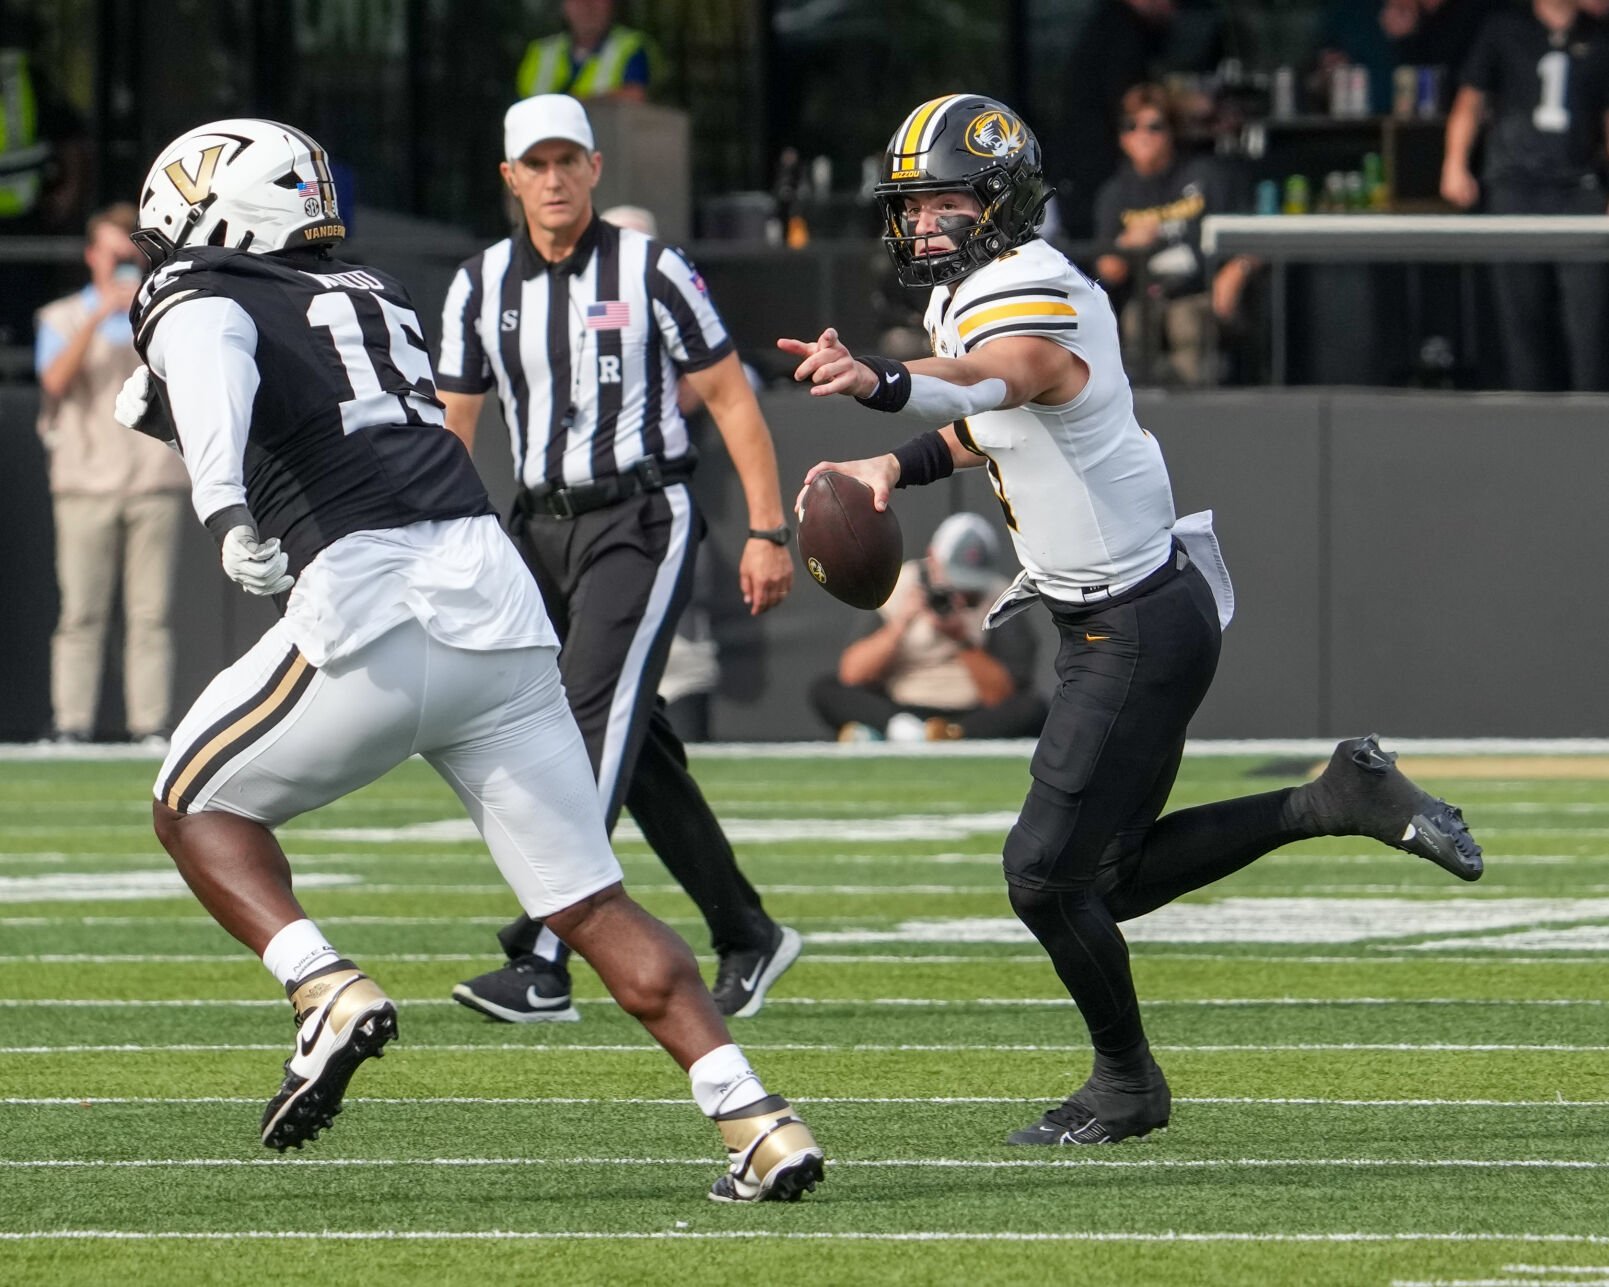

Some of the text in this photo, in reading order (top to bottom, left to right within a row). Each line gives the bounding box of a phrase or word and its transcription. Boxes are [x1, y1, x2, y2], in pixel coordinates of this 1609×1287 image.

[1532, 51, 1570, 133] 1
[161, 143, 228, 206] V
[891, 170, 920, 180] MIZZOU
[501, 309, 519, 332] S
[306, 291, 447, 436] 15
[599, 355, 622, 384] R
